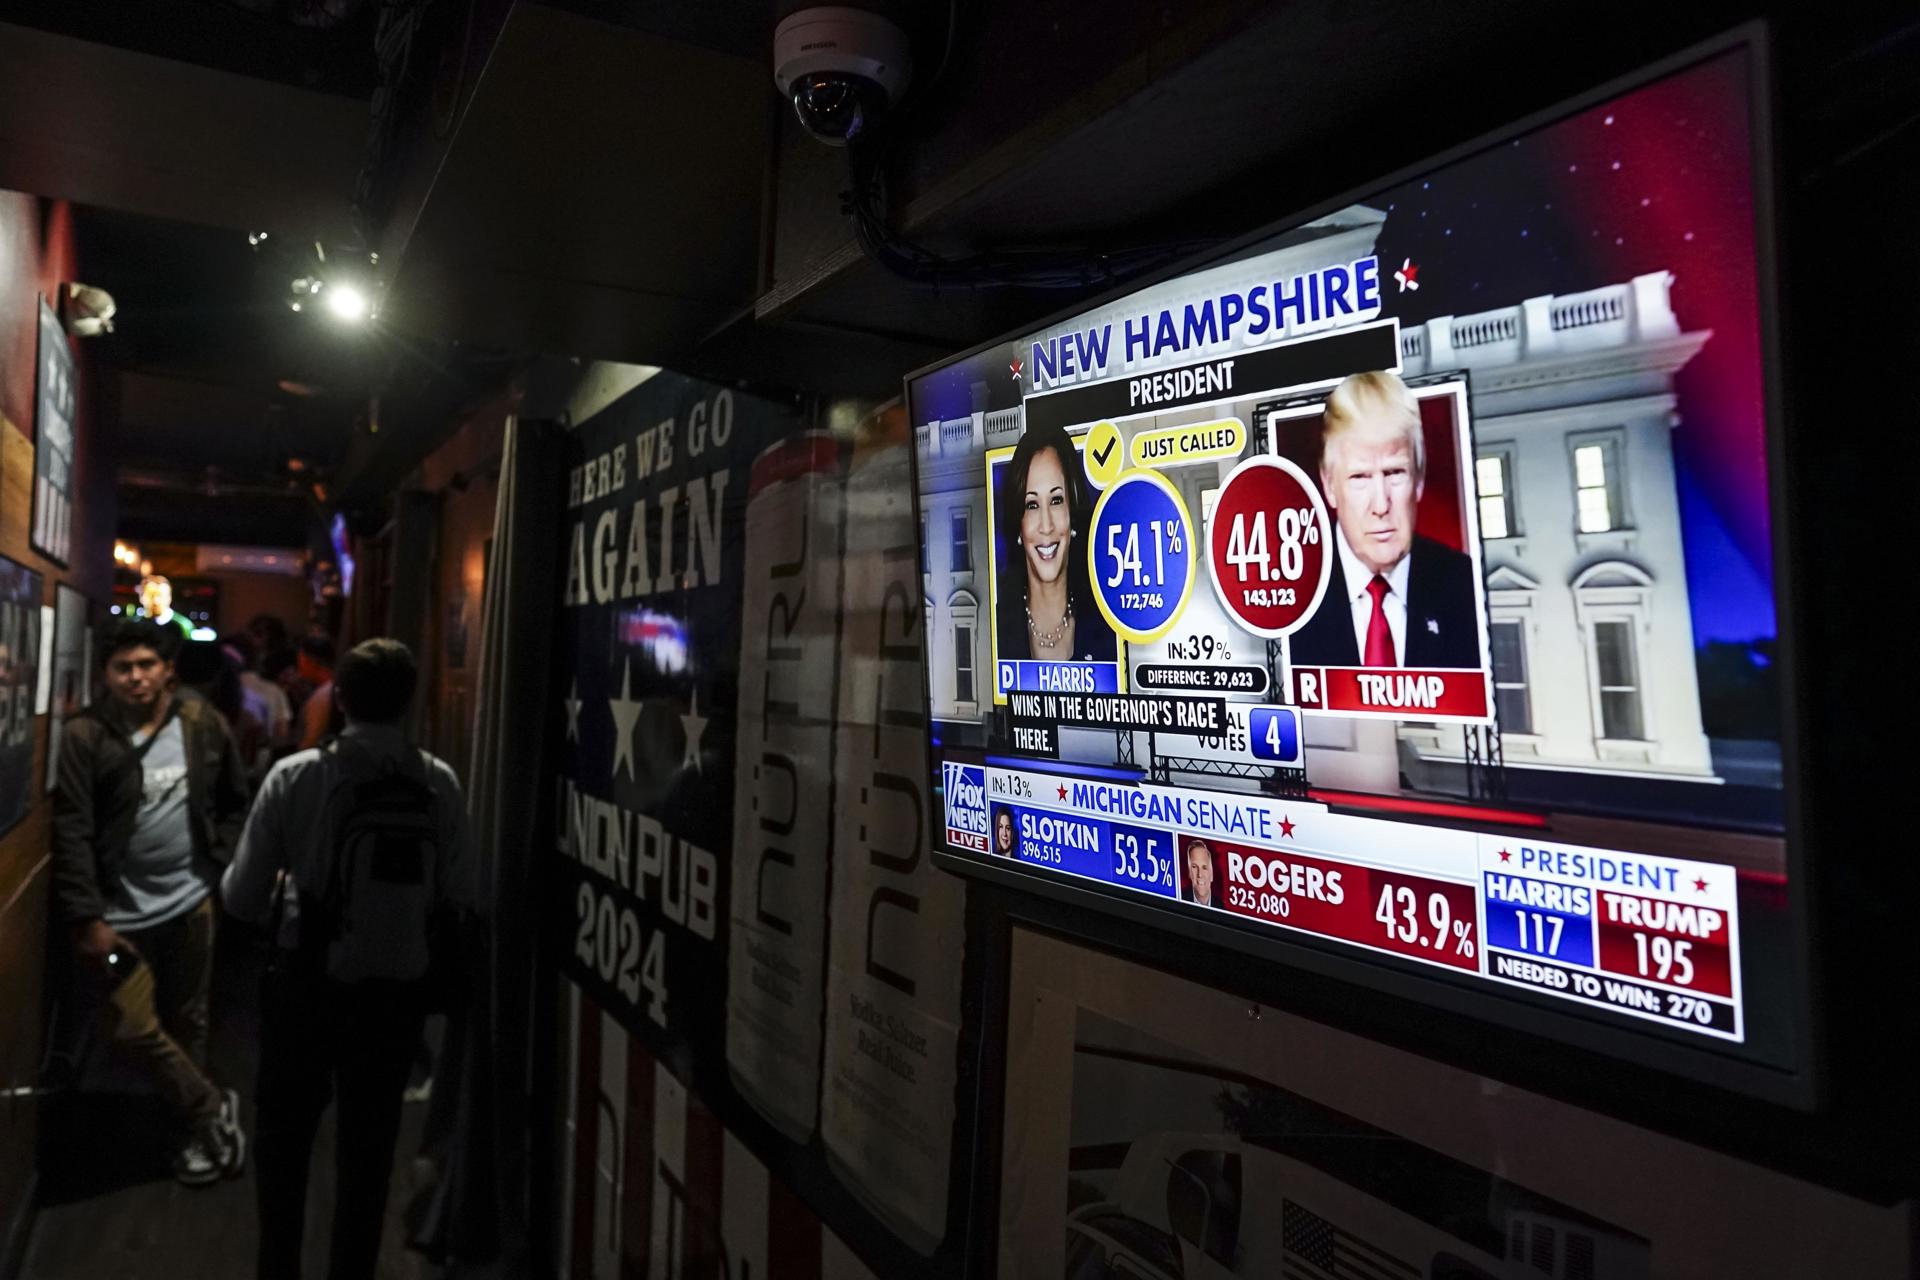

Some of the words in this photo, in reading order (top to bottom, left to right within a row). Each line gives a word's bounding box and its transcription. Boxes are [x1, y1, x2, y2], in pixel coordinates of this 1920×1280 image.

[1032, 332, 1110, 386] NEW
[1126, 258, 1380, 363] HAMPSHIRE
[1129, 361, 1234, 407] PRESIDENT
[567, 442, 627, 509] HERE
[636, 417, 675, 480] WE
[687, 388, 734, 458] GO
[1140, 435, 1175, 460] JUST
[1179, 428, 1236, 455] CALLED
[563, 468, 730, 609] AGAIN
[1107, 520, 1182, 588] 54.1%
[1226, 508, 1319, 582] 44.8%
[1120, 593, 1163, 611] 172,746
[1243, 588, 1296, 608] 143,123
[1001, 664, 1014, 689] D
[1039, 665, 1095, 693] HARRIS
[1148, 670, 1211, 686] DIFFERENCE:
[1213, 671, 1254, 688] 29,623
[1300, 672, 1320, 703] R
[1356, 674, 1445, 708] TRUMP
[1012, 694, 1041, 717] WINS
[1044, 696, 1057, 718] IN
[1060, 697, 1083, 720] THE
[1086, 698, 1172, 726] GOVERNOR'S
[1177, 701, 1219, 729] RACE
[1013, 727, 1053, 752] THERE.
[1265, 715, 1281, 755] 4
[957, 782, 985, 809] FOX
[1072, 783, 1182, 824] MICHIGAN
[1187, 798, 1272, 839] SENATE
[951, 806, 987, 833] NEWS
[951, 831, 984, 849] LIVE
[1021, 813, 1099, 853] SLOTKIN
[1022, 841, 1062, 865] 396,515
[1115, 832, 1173, 887] 53.5%
[1521, 847, 1679, 892] PRESIDENT
[634, 812, 718, 942] PUB
[1227, 851, 1345, 906] ROGERS
[1486, 874, 1591, 917] HARRIS
[1229, 886, 1290, 919] 325,080
[1375, 883, 1475, 959] 43.9%
[1603, 893, 1723, 939] TRUMP
[575, 879, 668, 1030] 2024
[1515, 909, 1565, 957] 117
[1634, 932, 1694, 986] 195
[1497, 955, 1569, 991] NEEDED
[1571, 973, 1601, 997] TO
[1603, 980, 1660, 1012] WIN:
[1668, 997, 1713, 1025] 270
